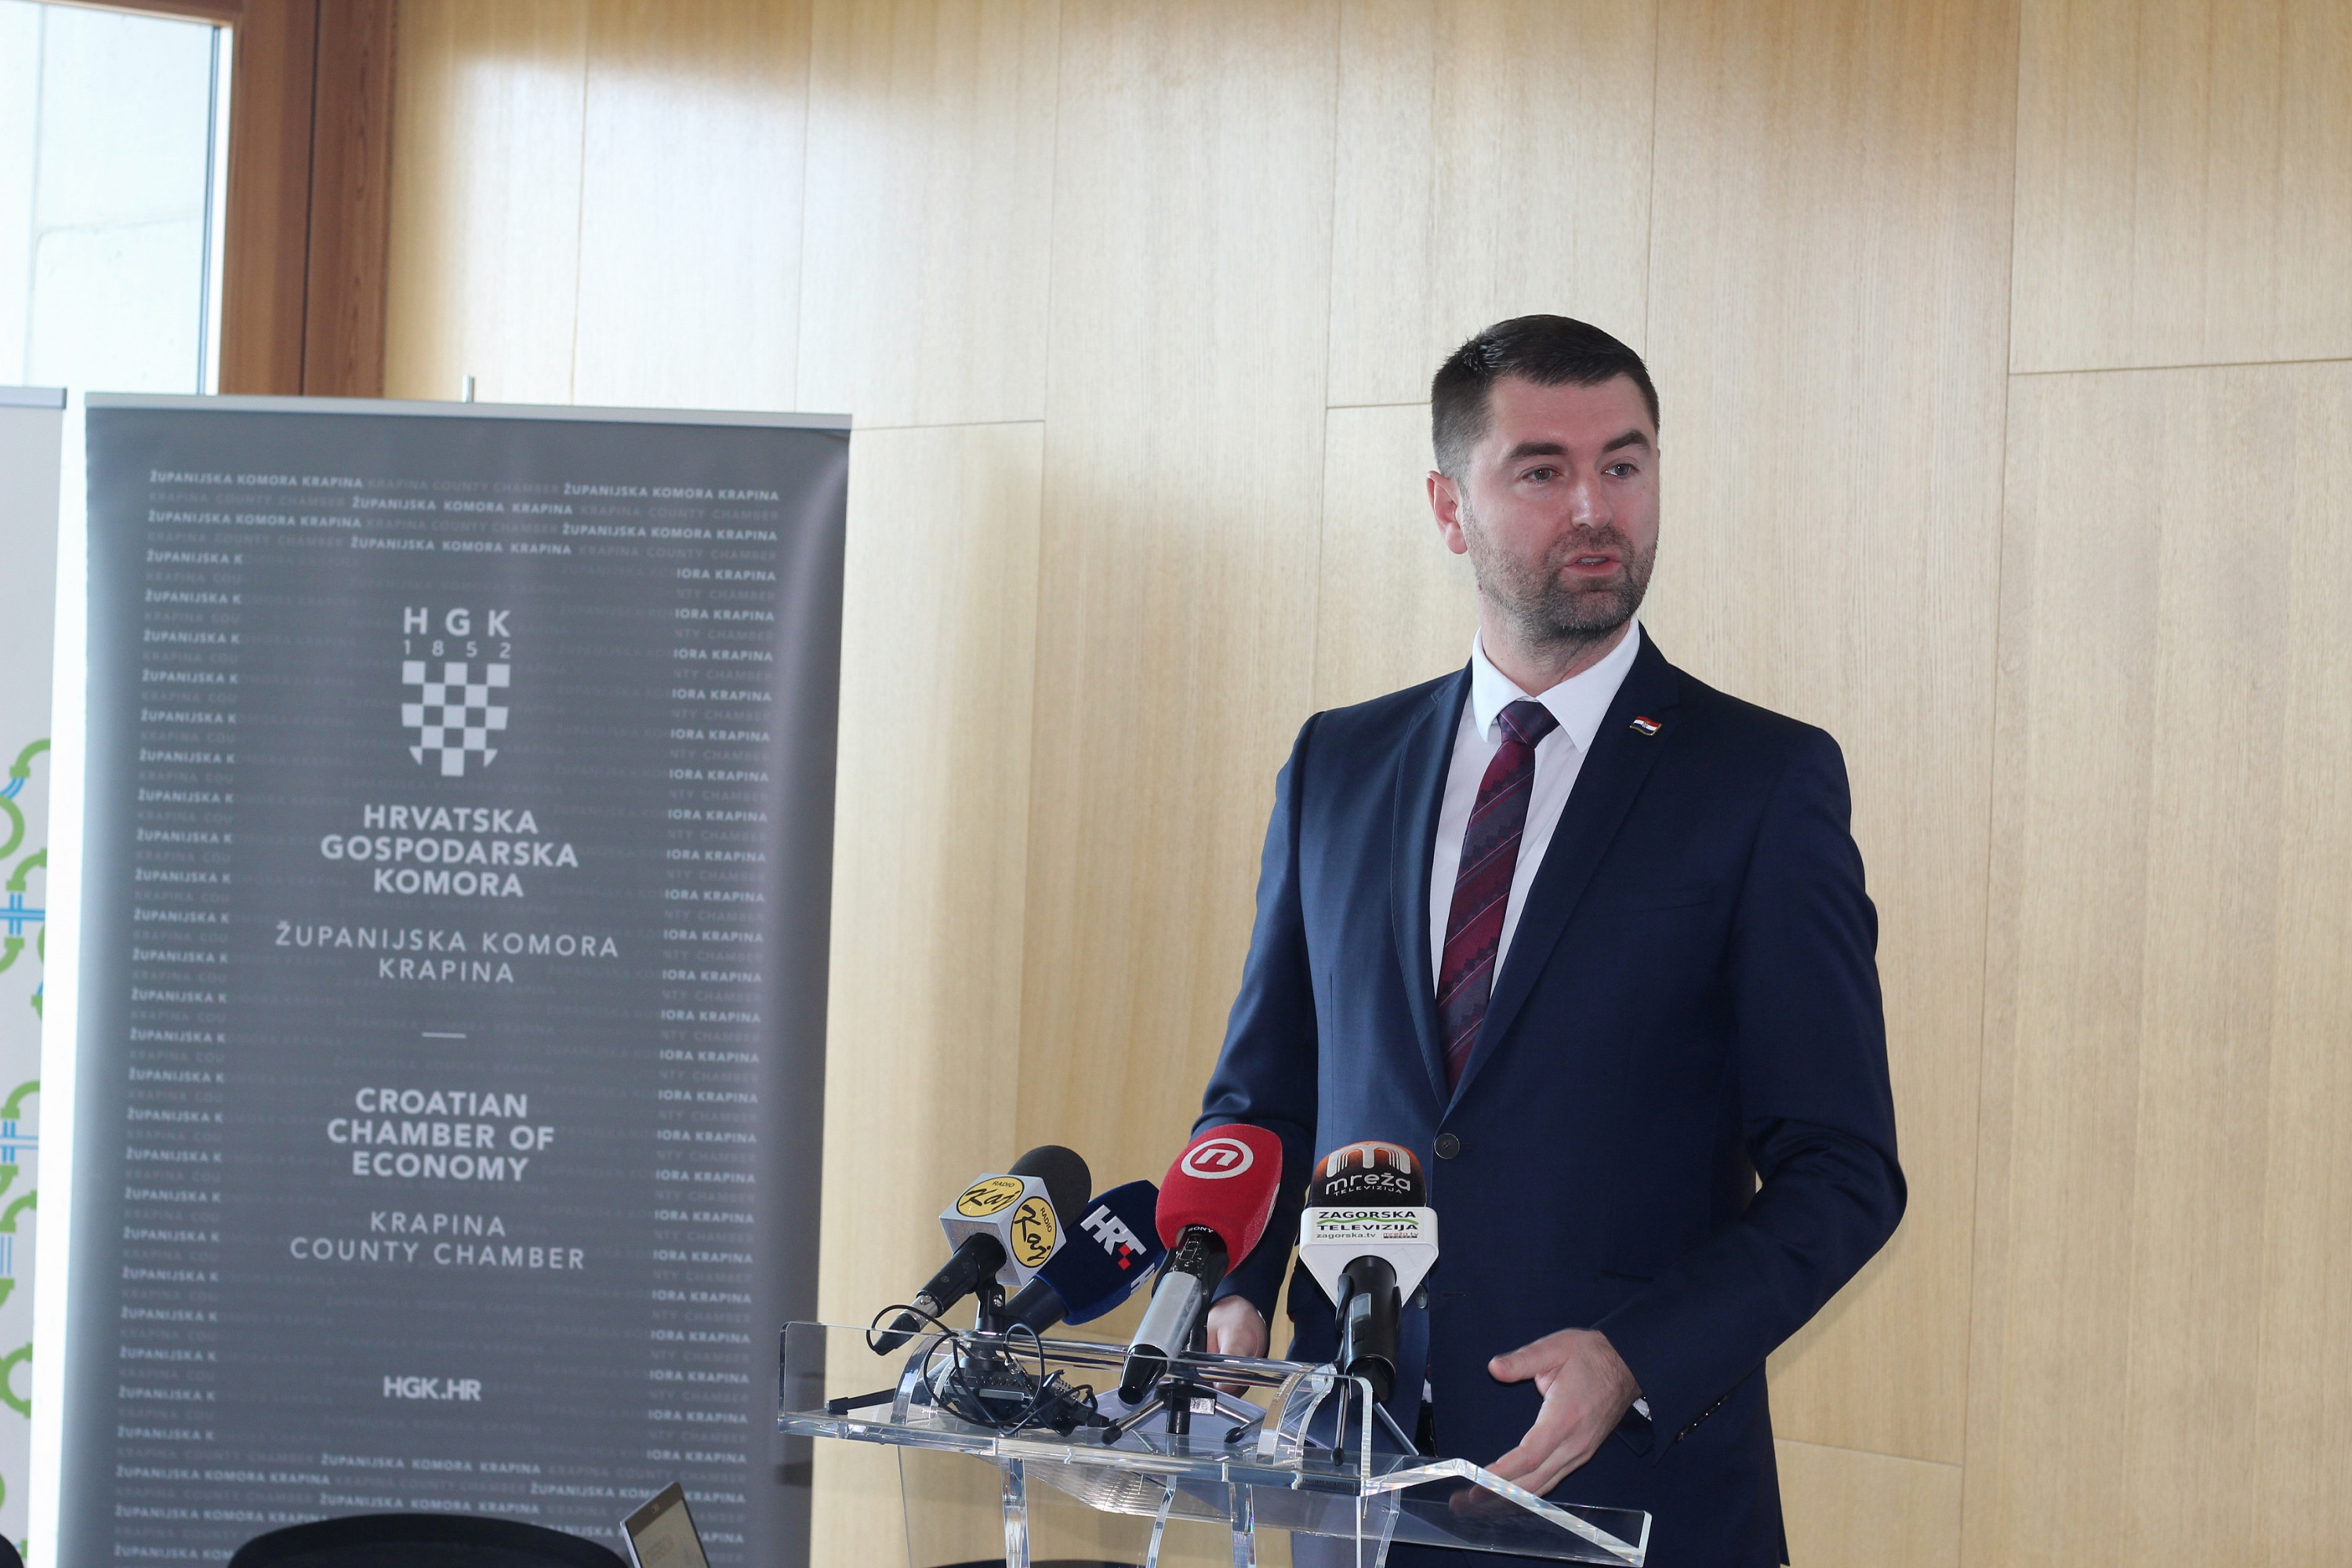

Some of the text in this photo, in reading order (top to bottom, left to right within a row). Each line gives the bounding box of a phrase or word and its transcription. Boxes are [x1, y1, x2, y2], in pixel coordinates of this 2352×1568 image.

[150, 469, 363, 488] ŽUPANIJSKA KOMORA KRAPINA
[564, 482, 779, 500] ŽUPANIJSKA KOMORA KRAPINA
[353, 495, 572, 514] ŽUPANIJSKA KOMORA KRAPINA
[149, 510, 361, 528] ŽUPANIJSKA KOMORA KRAPINA
[562, 522, 777, 540] ŽUPANIJSKA KOMORA KRAPINA
[350, 535, 572, 554] ŽUPANIJSKA KOMORA KRAPINA
[147, 550, 229, 563] ŽUPANIJSKA
[715, 569, 775, 580] KRAPINA
[145, 589, 227, 603] ŽUPANIJSKA
[713, 610, 774, 620] KRAPINA
[144, 630, 226, 643] ŽUPANIJSKA
[712, 650, 772, 660] KRAPINA
[143, 669, 224, 683] ŽUPANIJSKA
[710, 690, 771, 701] KRAPINA
[141, 709, 223, 723] ŽUPANIJSKA
[709, 730, 770, 742] KRAPINA
[140, 749, 221, 763] ŽUPANIJSKA
[708, 770, 769, 782] KRAPINA
[139, 789, 220, 802] ŽUPANIJSKA
[364, 804, 539, 834] HRVATSKA
[706, 811, 768, 822] KRAPINA
[137, 828, 219, 843] ŽUPANIJSKA
[320, 833, 579, 868] GOSPODARSKA
[705, 851, 767, 862] KRAPINA
[136, 869, 217, 883] ŽUPANIJSKA
[373, 868, 524, 898] KOMORA
[703, 891, 765, 903] KRAPINA
[134, 908, 216, 923] ŽUPANIJSKA
[275, 920, 619, 958] ŽUPANIJSKA KOMORA
[702, 931, 764, 942] KRAPINA
[133, 948, 215, 962] ŽUPANIJSKA
[379, 958, 514, 983] KRAPINA
[701, 971, 762, 982] KRAPINA
[132, 988, 213, 1002] ŽUPANIJSKA
[699, 1011, 761, 1023] KRAPINA
[130, 1028, 212, 1042] ŽUPANIJSKA
[698, 1051, 760, 1063] KRAPINA
[129, 1067, 211, 1082] ŽUPANIJSKA
[355, 1087, 528, 1118] CROATIAN
[697, 1091, 758, 1103] KRAPINA
[128, 1108, 209, 1122] ŽUPANIJSKA
[327, 1117, 555, 1151] CHAMBER OF
[695, 1131, 757, 1143] KRAPINA
[126, 1147, 209, 1162] ŽUPANIJSKA
[352, 1151, 529, 1181] ECONOMY
[694, 1172, 756, 1183] KRAPINA
[1325, 1173, 1410, 1196] mreža
[125, 1187, 207, 1201] ŽUPANIJSKA
[1333, 1185, 1403, 1196] TELEVIZIJA
[960, 1188, 1021, 1211] Kaj
[370, 1211, 506, 1237] KRAPINA
[693, 1212, 754, 1223] KRAPINA
[1040, 1207, 1052, 1233] RADIO
[124, 1227, 206, 1241] ŽUPANIJSKA
[1014, 1204, 1051, 1262] Kaj
[1080, 1204, 1147, 1257] HRT
[290, 1236, 584, 1269] COUNTY CHAMBER
[691, 1252, 753, 1263] KRAPINA
[123, 1266, 205, 1281] ŽUPANIJSKA
[690, 1292, 752, 1304] KRAPINA
[122, 1306, 204, 1321] ŽUPANIJSKA
[689, 1332, 750, 1343] KRAPINA
[120, 1346, 203, 1360] ŽUPANIJSKA
[688, 1372, 749, 1383] KRAPINA
[119, 1385, 201, 1400] ŽUPANIJSKA
[383, 1375, 482, 1402] HGK.HR
[687, 1411, 747, 1423] KRAPINA
[118, 1425, 201, 1439] ŽUPANIJSKA
[321, 1453, 540, 1474] ŽUPANIJSKA KOMORA KRAPINA
[685, 1452, 746, 1463] KRAPINA
[117, 1465, 330, 1485] ŽUPANIJSKA KOMORA KRAPINA
[530, 1482, 615, 1497] ŽUPANIJSKA
[320, 1493, 539, 1514] ŽUPANIJSKA KOMORA KRAPINA
[115, 1504, 198, 1519] ŽUPANIJSKA
[204, 1510, 264, 1522] KOMORA
[114, 1544, 234, 1560] ŽUPANIJSKA KOM
